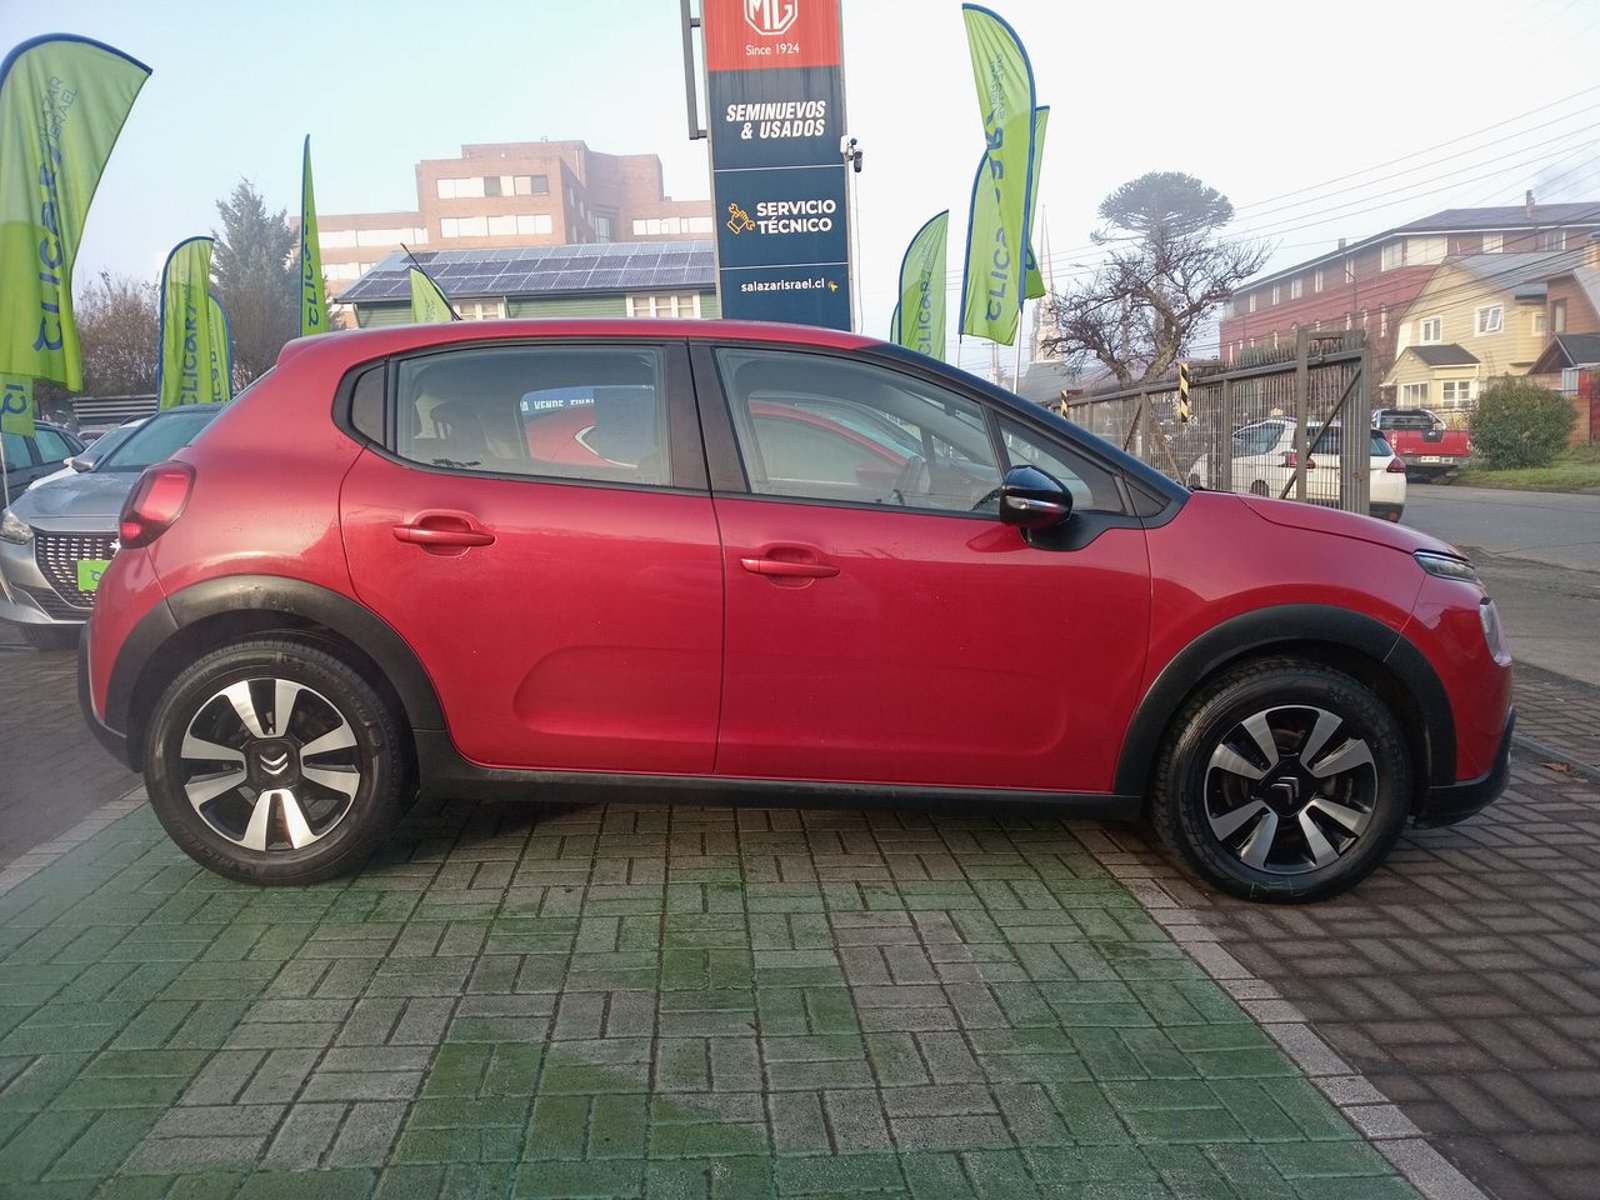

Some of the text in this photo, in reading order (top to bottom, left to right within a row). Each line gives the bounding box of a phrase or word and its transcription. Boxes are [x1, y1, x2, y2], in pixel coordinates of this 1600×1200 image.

[748, 0, 793, 31] MG
[746, 43, 800, 56] Since 1924
[726, 100, 826, 122] SEMINUEVOS
[741, 119, 826, 140] & USADOS
[756, 199, 837, 217] SERVICIO
[757, 216, 833, 235] TÉCNICO
[740, 278, 825, 292] salazarisrael.cl
